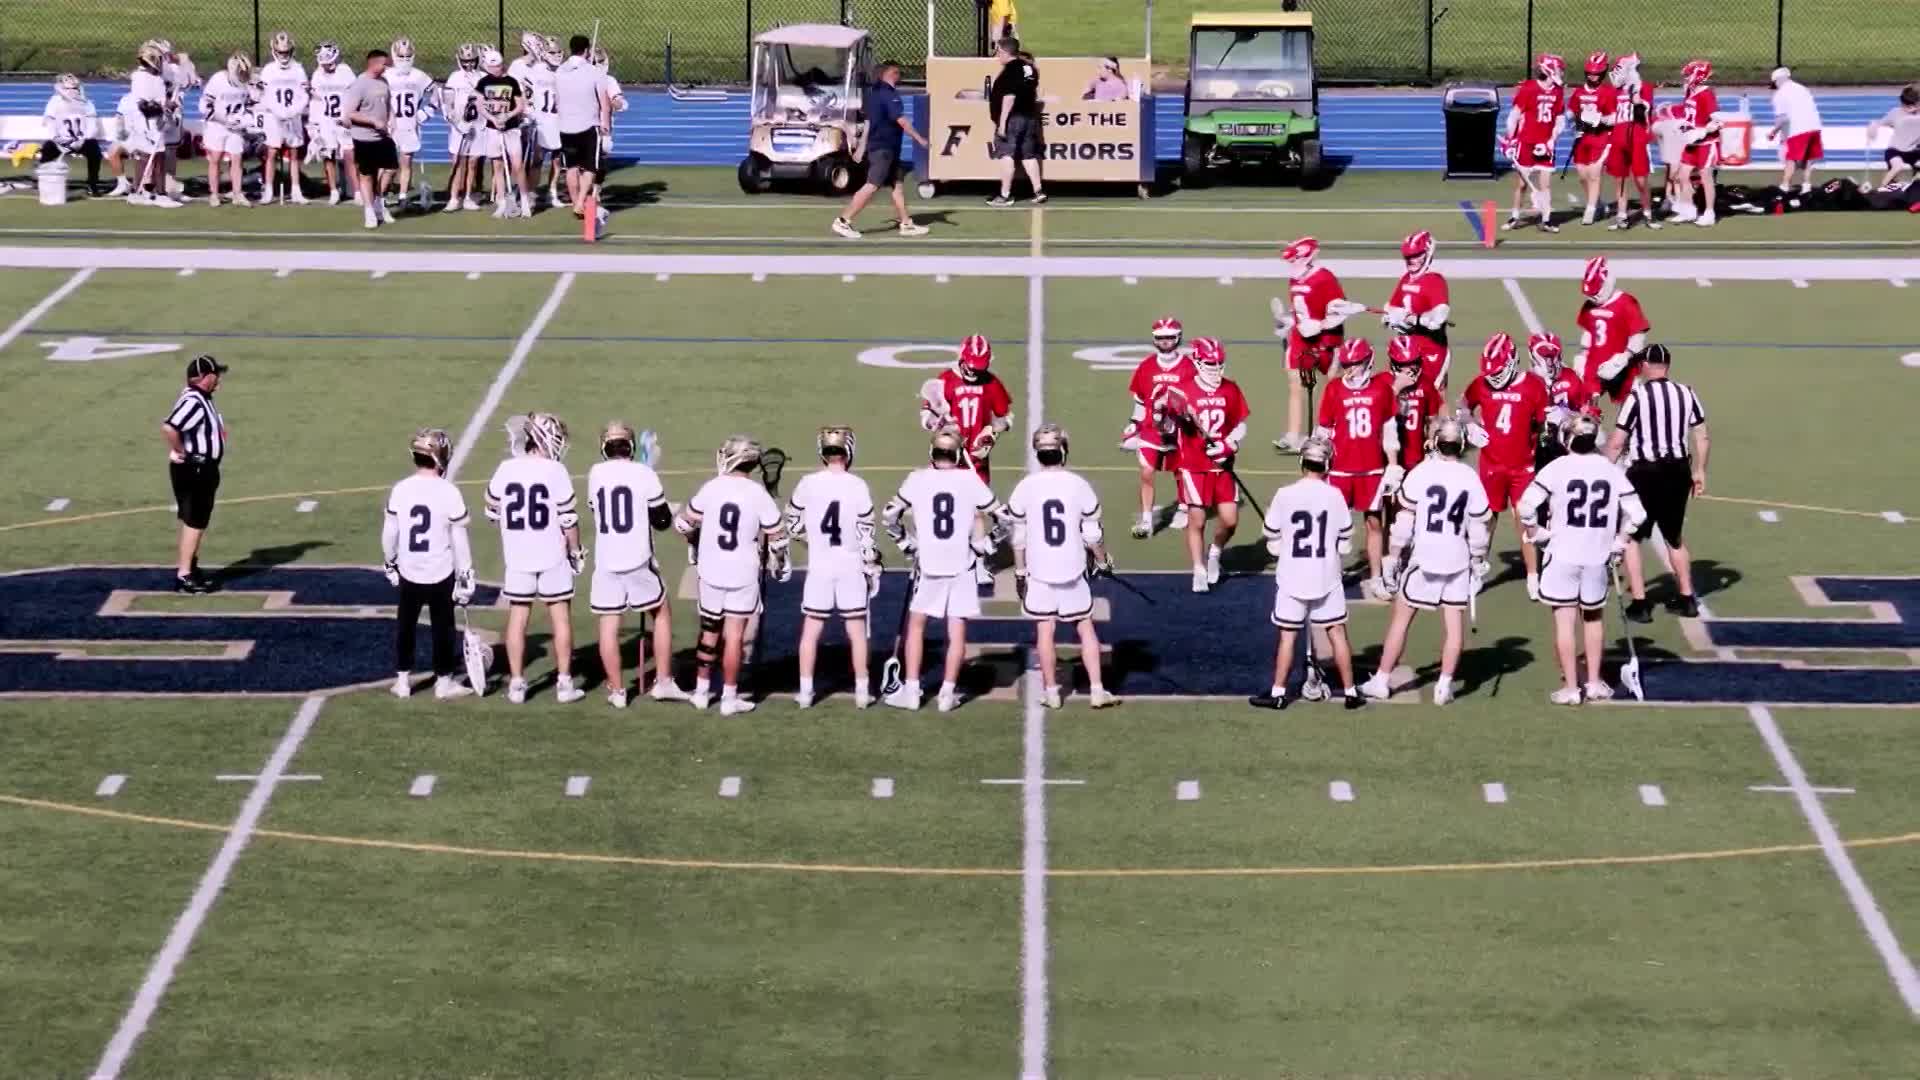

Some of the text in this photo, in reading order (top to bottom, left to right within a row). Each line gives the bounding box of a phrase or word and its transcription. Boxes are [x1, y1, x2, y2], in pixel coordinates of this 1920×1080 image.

[324, 94, 341, 117] 12
[396, 93, 415, 117] 15
[1056, 113, 1081, 126] OF
[1087, 113, 1127, 126] THE
[1537, 102, 1553, 122] 15
[941, 125, 971, 156] F
[1596, 320, 1608, 346] 3
[958, 397, 980, 428] 11
[1200, 409, 1225, 438] 12
[1345, 407, 1372, 439] 18
[1496, 404, 1512, 434] 4
[505, 483, 550, 530] 26
[597, 485, 633, 534] 10
[820, 500, 842, 546] 4
[932, 492, 955, 540] 8
[1043, 498, 1066, 547] 6
[1426, 485, 1469, 536] 24
[1566, 479, 1611, 528] 22
[408, 504, 431, 552] 2
[717, 502, 741, 551] 9
[1291, 510, 1328, 558] 21
